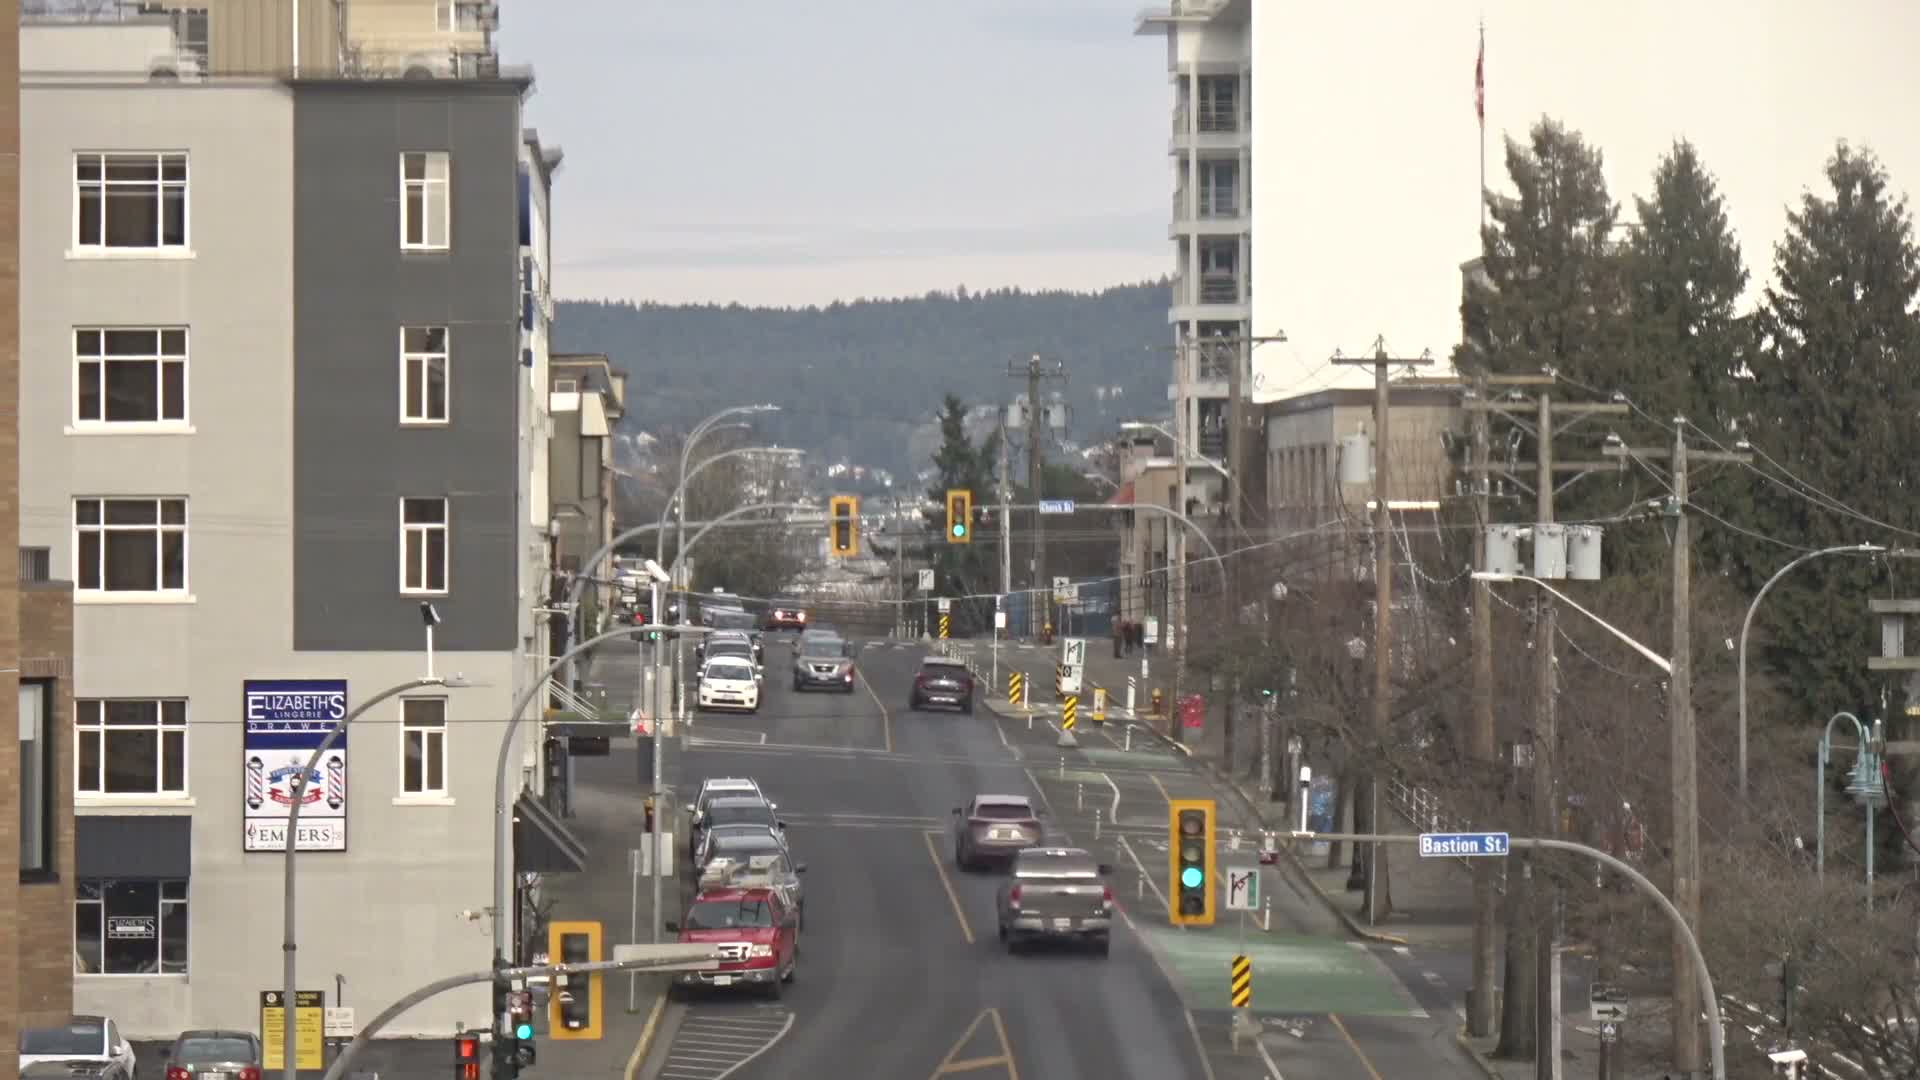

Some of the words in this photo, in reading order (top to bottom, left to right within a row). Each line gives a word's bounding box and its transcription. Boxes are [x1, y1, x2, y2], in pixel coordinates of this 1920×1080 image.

[248, 695, 345, 719] ELIZABETH'S
[250, 722, 342, 730] DRAWE
[259, 829, 330, 842] EMERS
[1422, 837, 1478, 853] Bastion
[1485, 836, 1506, 852] St.
